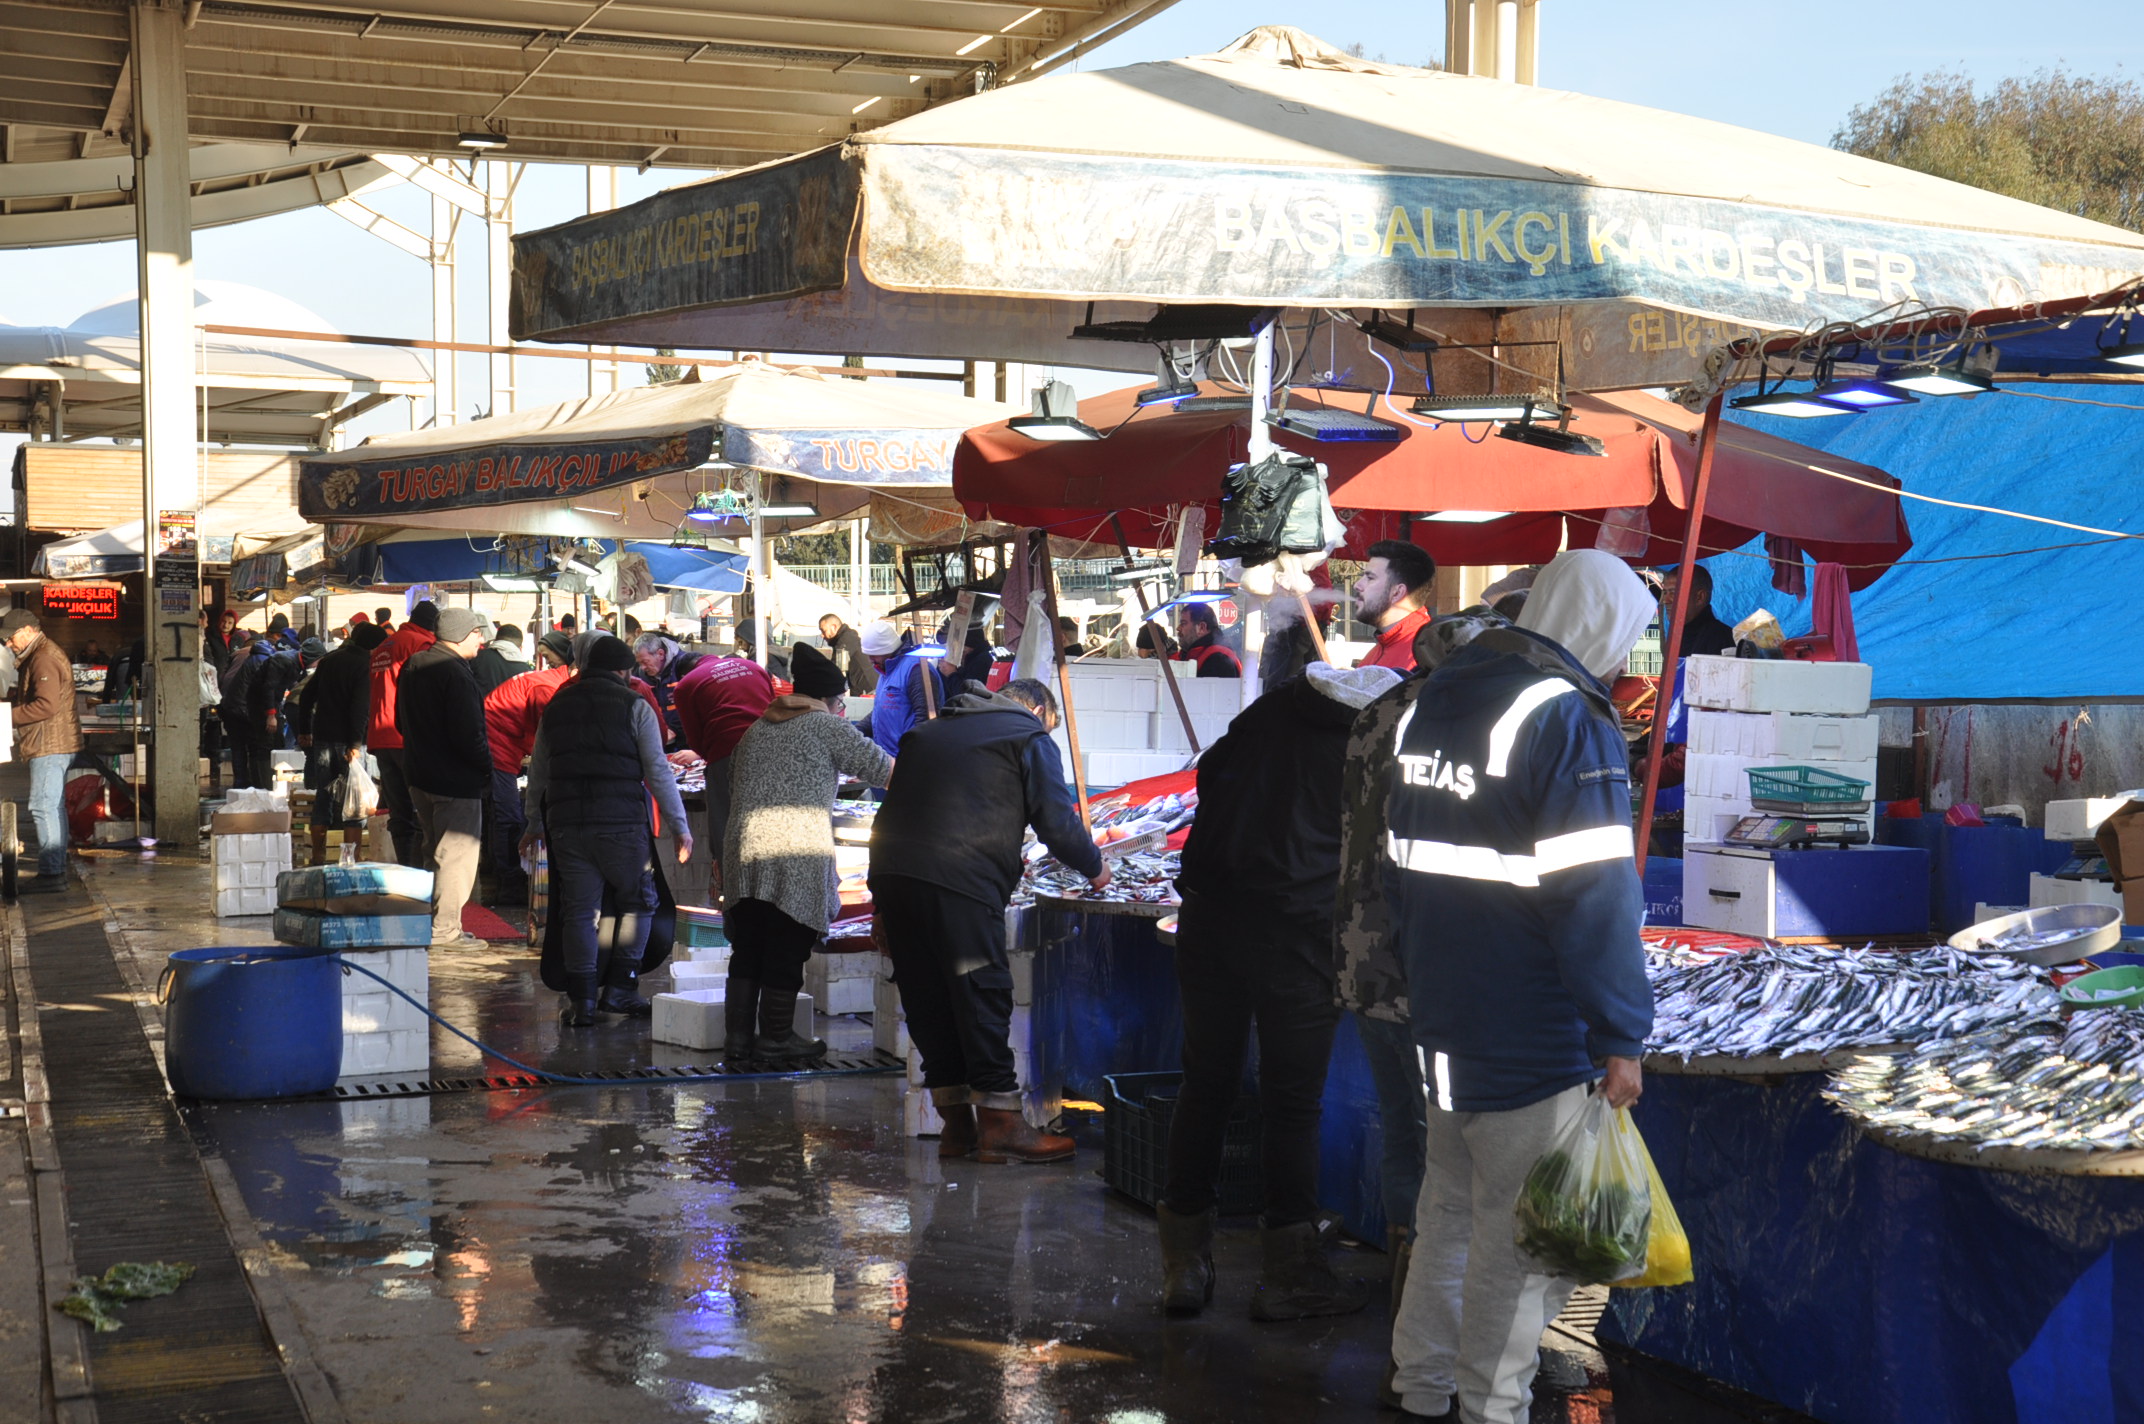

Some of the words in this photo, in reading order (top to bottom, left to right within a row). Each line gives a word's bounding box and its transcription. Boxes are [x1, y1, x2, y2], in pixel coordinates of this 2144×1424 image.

[571, 226, 653, 297] BAŞBALIKÇI
[655, 201, 760, 273] KARDEŞLER
[1213, 197, 1572, 277] BAŞBALIKÇI
[1587, 214, 1919, 303] KARDEŞLER
[809, 437, 948, 473] TURGAY
[377, 460, 474, 503] TURGAY
[46, 588, 113, 600] KARDEŞLER
[1398, 750, 1476, 800] TEİAŞ
